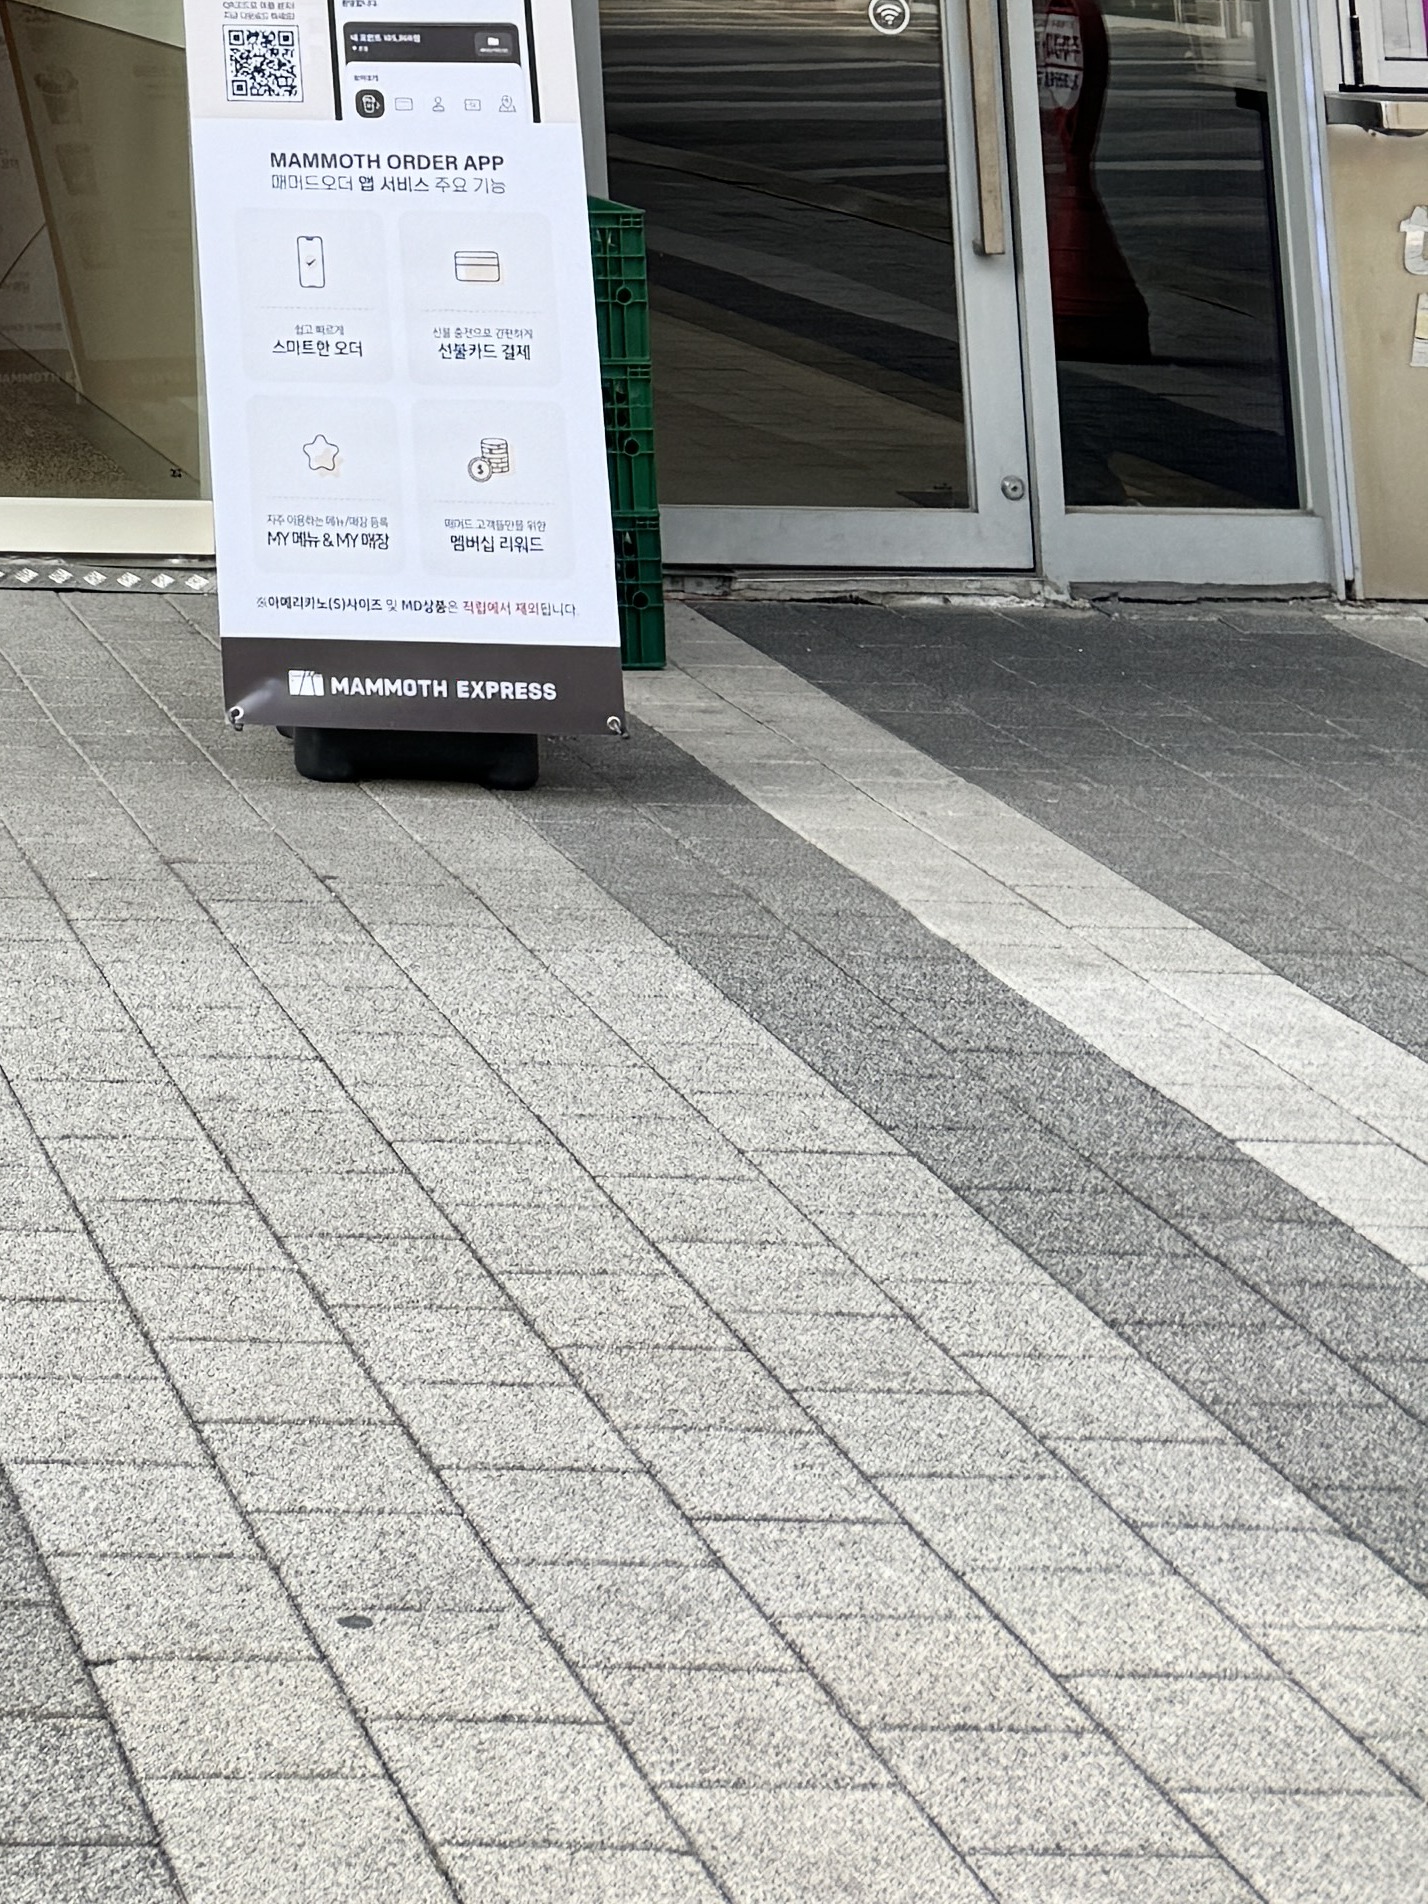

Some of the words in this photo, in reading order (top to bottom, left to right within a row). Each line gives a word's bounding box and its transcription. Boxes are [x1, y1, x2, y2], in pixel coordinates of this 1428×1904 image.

[270, 152, 381, 169] MAMMOTH
[387, 154, 457, 170] ORDER
[464, 156, 504, 171] APP
[271, 175, 353, 192] 매머드오더
[359, 175, 374, 192] 앱
[380, 176, 429, 192] 서비스
[435, 178, 467, 193] 주요
[473, 178, 506, 194] 기능
[272, 340, 331, 358] 스마트한
[334, 340, 363, 358] 오더
[438, 343, 497, 360] 선물카드
[502, 344, 530, 361] 결제
[267, 531, 289, 547] MY
[292, 530, 320, 549] 메뉴
[323, 533, 334, 547] &
[336, 532, 358, 549] MY
[362, 532, 389, 550] 매장
[450, 534, 494, 553] 멤버십
[500, 535, 544, 554] 리워드
[331, 677, 447, 698] MAMMOTH
[457, 680, 557, 701] EXPRESS
